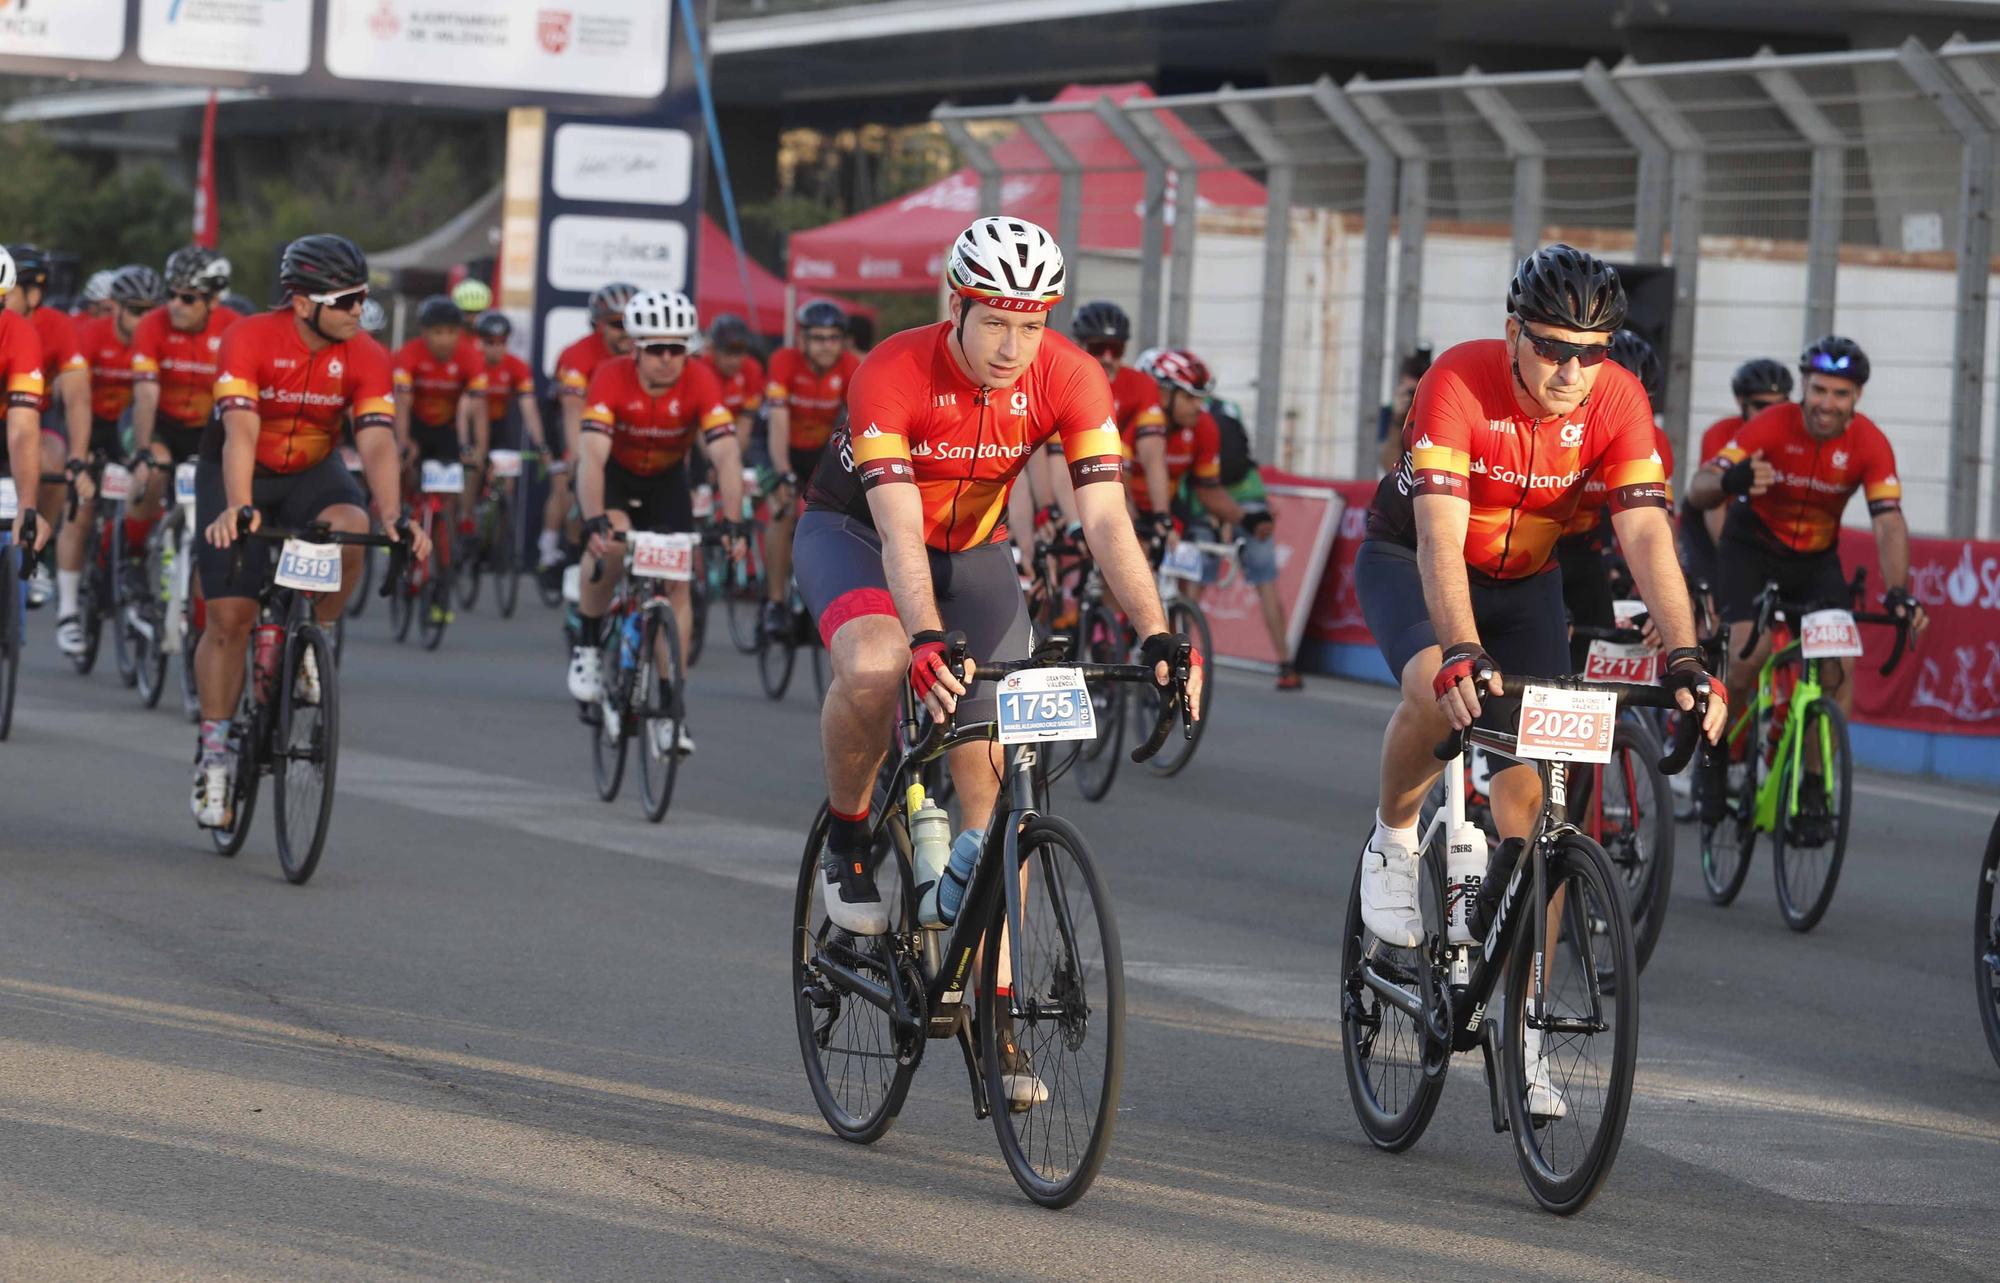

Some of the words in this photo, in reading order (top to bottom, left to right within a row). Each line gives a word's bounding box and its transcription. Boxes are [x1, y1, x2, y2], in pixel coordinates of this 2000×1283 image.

[989, 298, 1045, 312] GOBIK
[1488, 465, 1590, 489] Santander
[286, 554, 332, 578] 1519
[1591, 656, 1642, 678] 2717
[1006, 692, 1074, 721] 1755
[1079, 691, 1088, 706] km
[1080, 708, 1090, 726] 105
[1526, 710, 1595, 740] 2026
[1450, 844, 1473, 854] 226ERS
